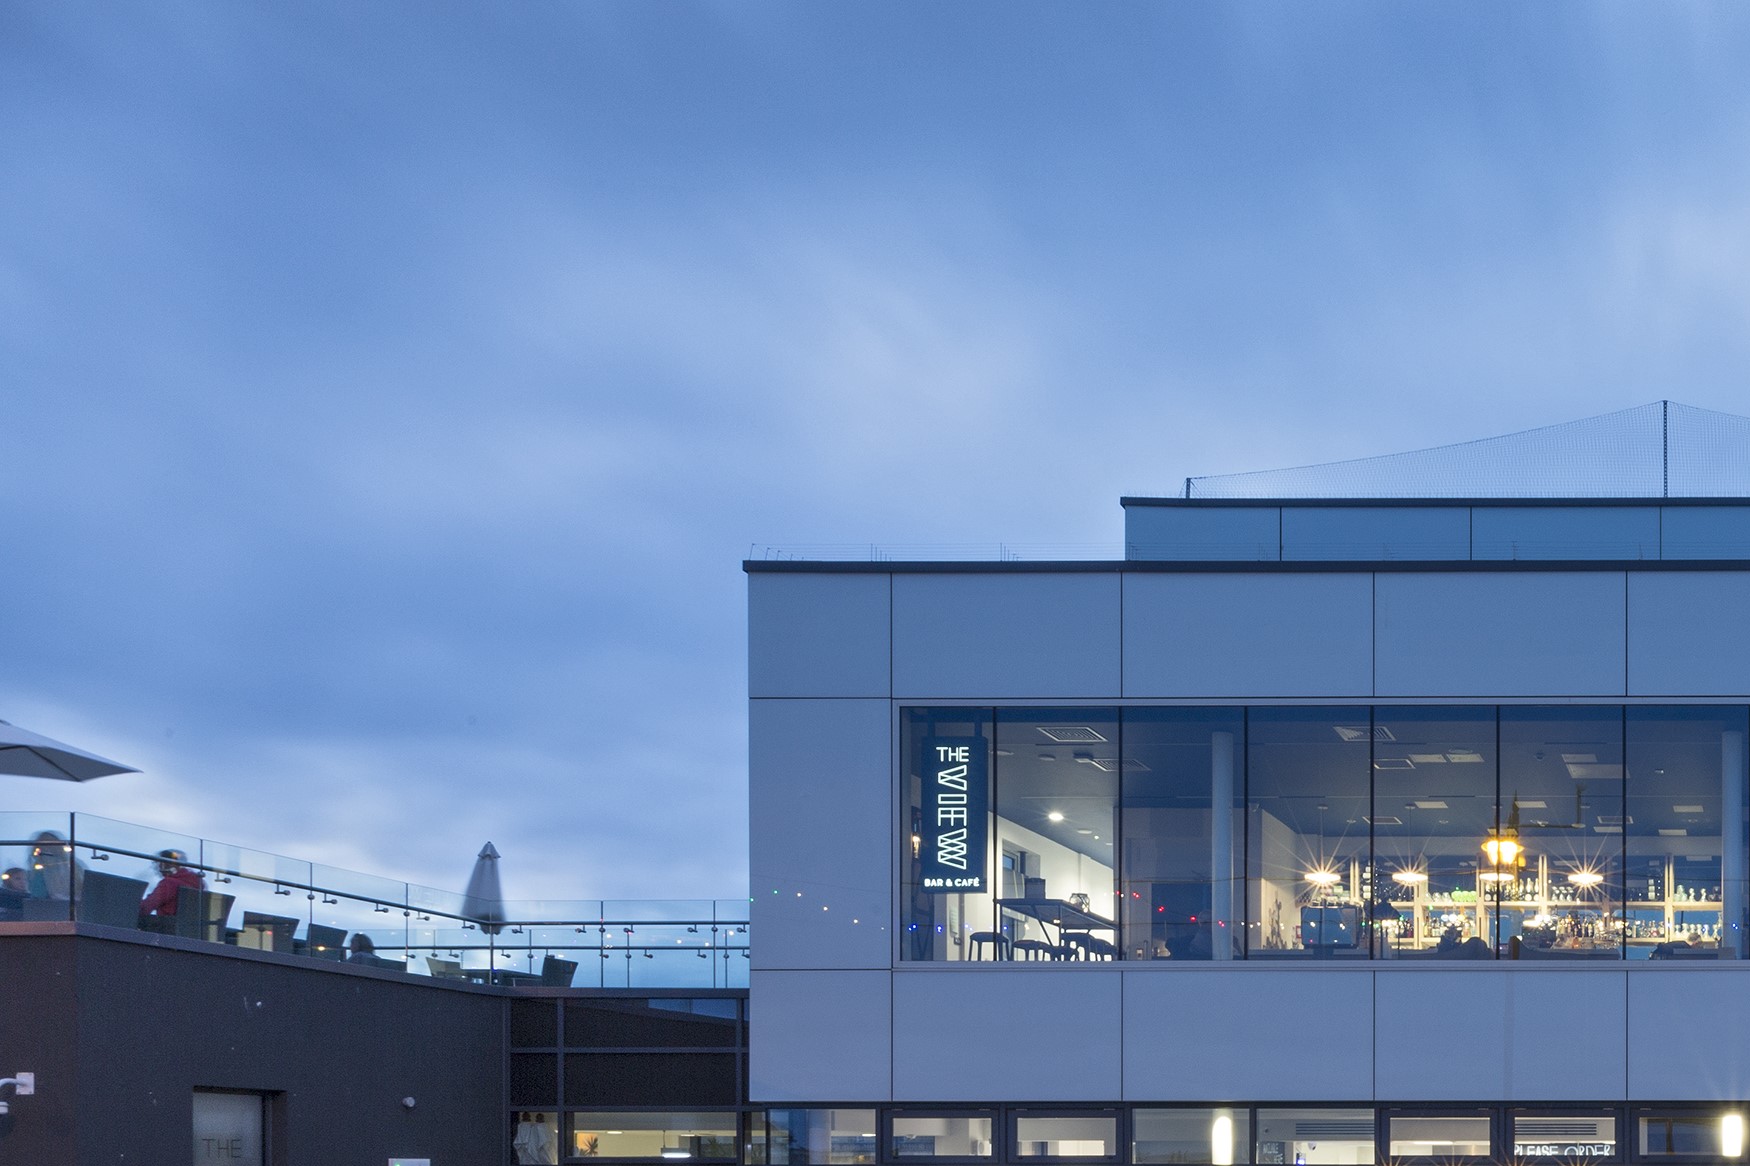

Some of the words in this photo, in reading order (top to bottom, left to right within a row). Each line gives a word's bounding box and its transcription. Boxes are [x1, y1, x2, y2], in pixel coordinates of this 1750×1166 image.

[936, 746, 970, 763] THE
[937, 764, 968, 871] VIEW
[924, 878, 943, 887] BAR
[945, 878, 953, 887] &
[954, 876, 980, 887] CAFÉ
[202, 1138, 243, 1159] THE
